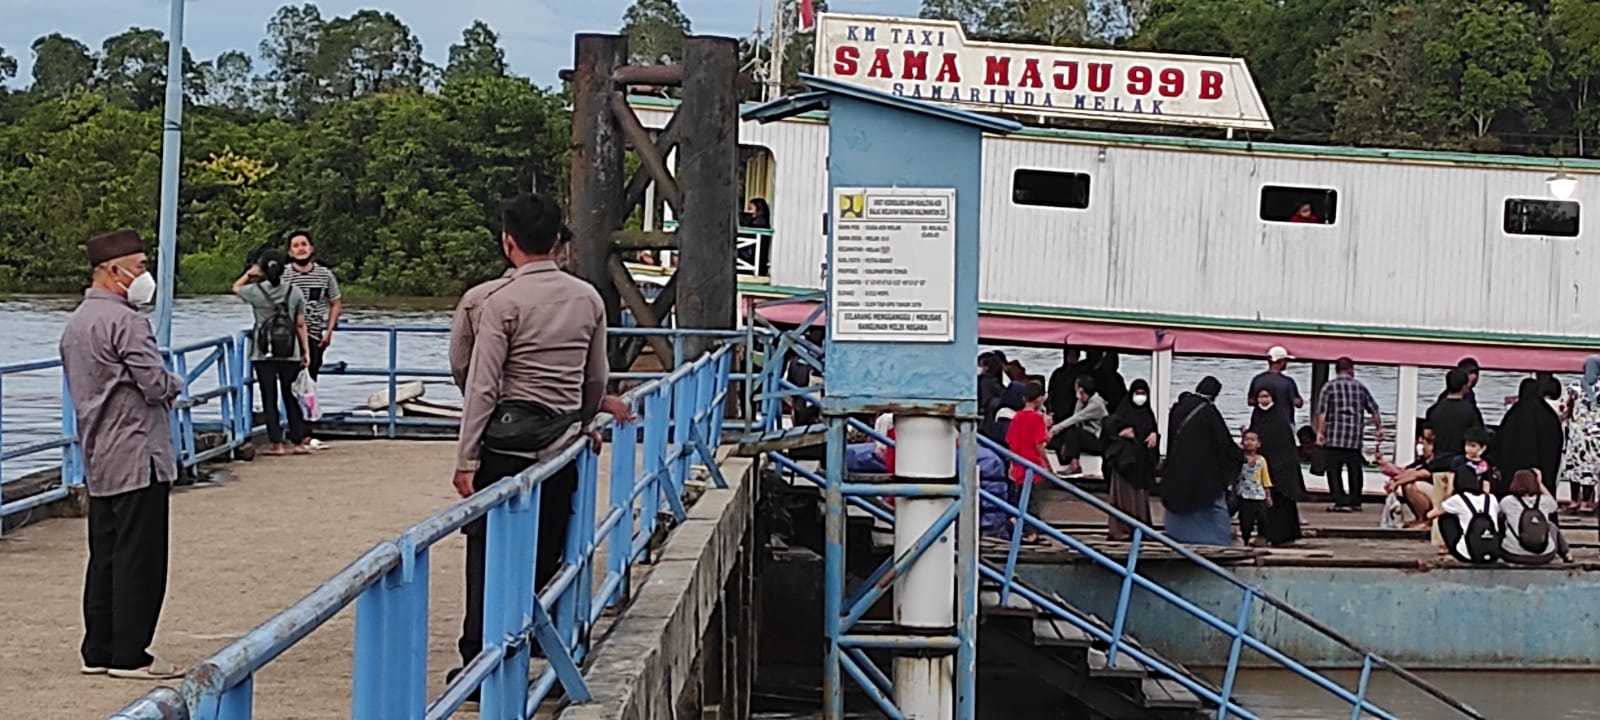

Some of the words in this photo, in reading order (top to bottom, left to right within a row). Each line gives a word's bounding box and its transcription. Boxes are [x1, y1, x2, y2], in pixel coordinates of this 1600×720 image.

[847, 25, 875, 42] KM
[890, 28, 944, 46] TAXI
[834, 45, 961, 82] SAMA
[984, 56, 1113, 93] MAJU
[1126, 65, 1184, 98] 99
[1198, 69, 1224, 100] B
[892, 82, 1053, 108] SAMARINDA
[1074, 94, 1164, 114] MELAK
